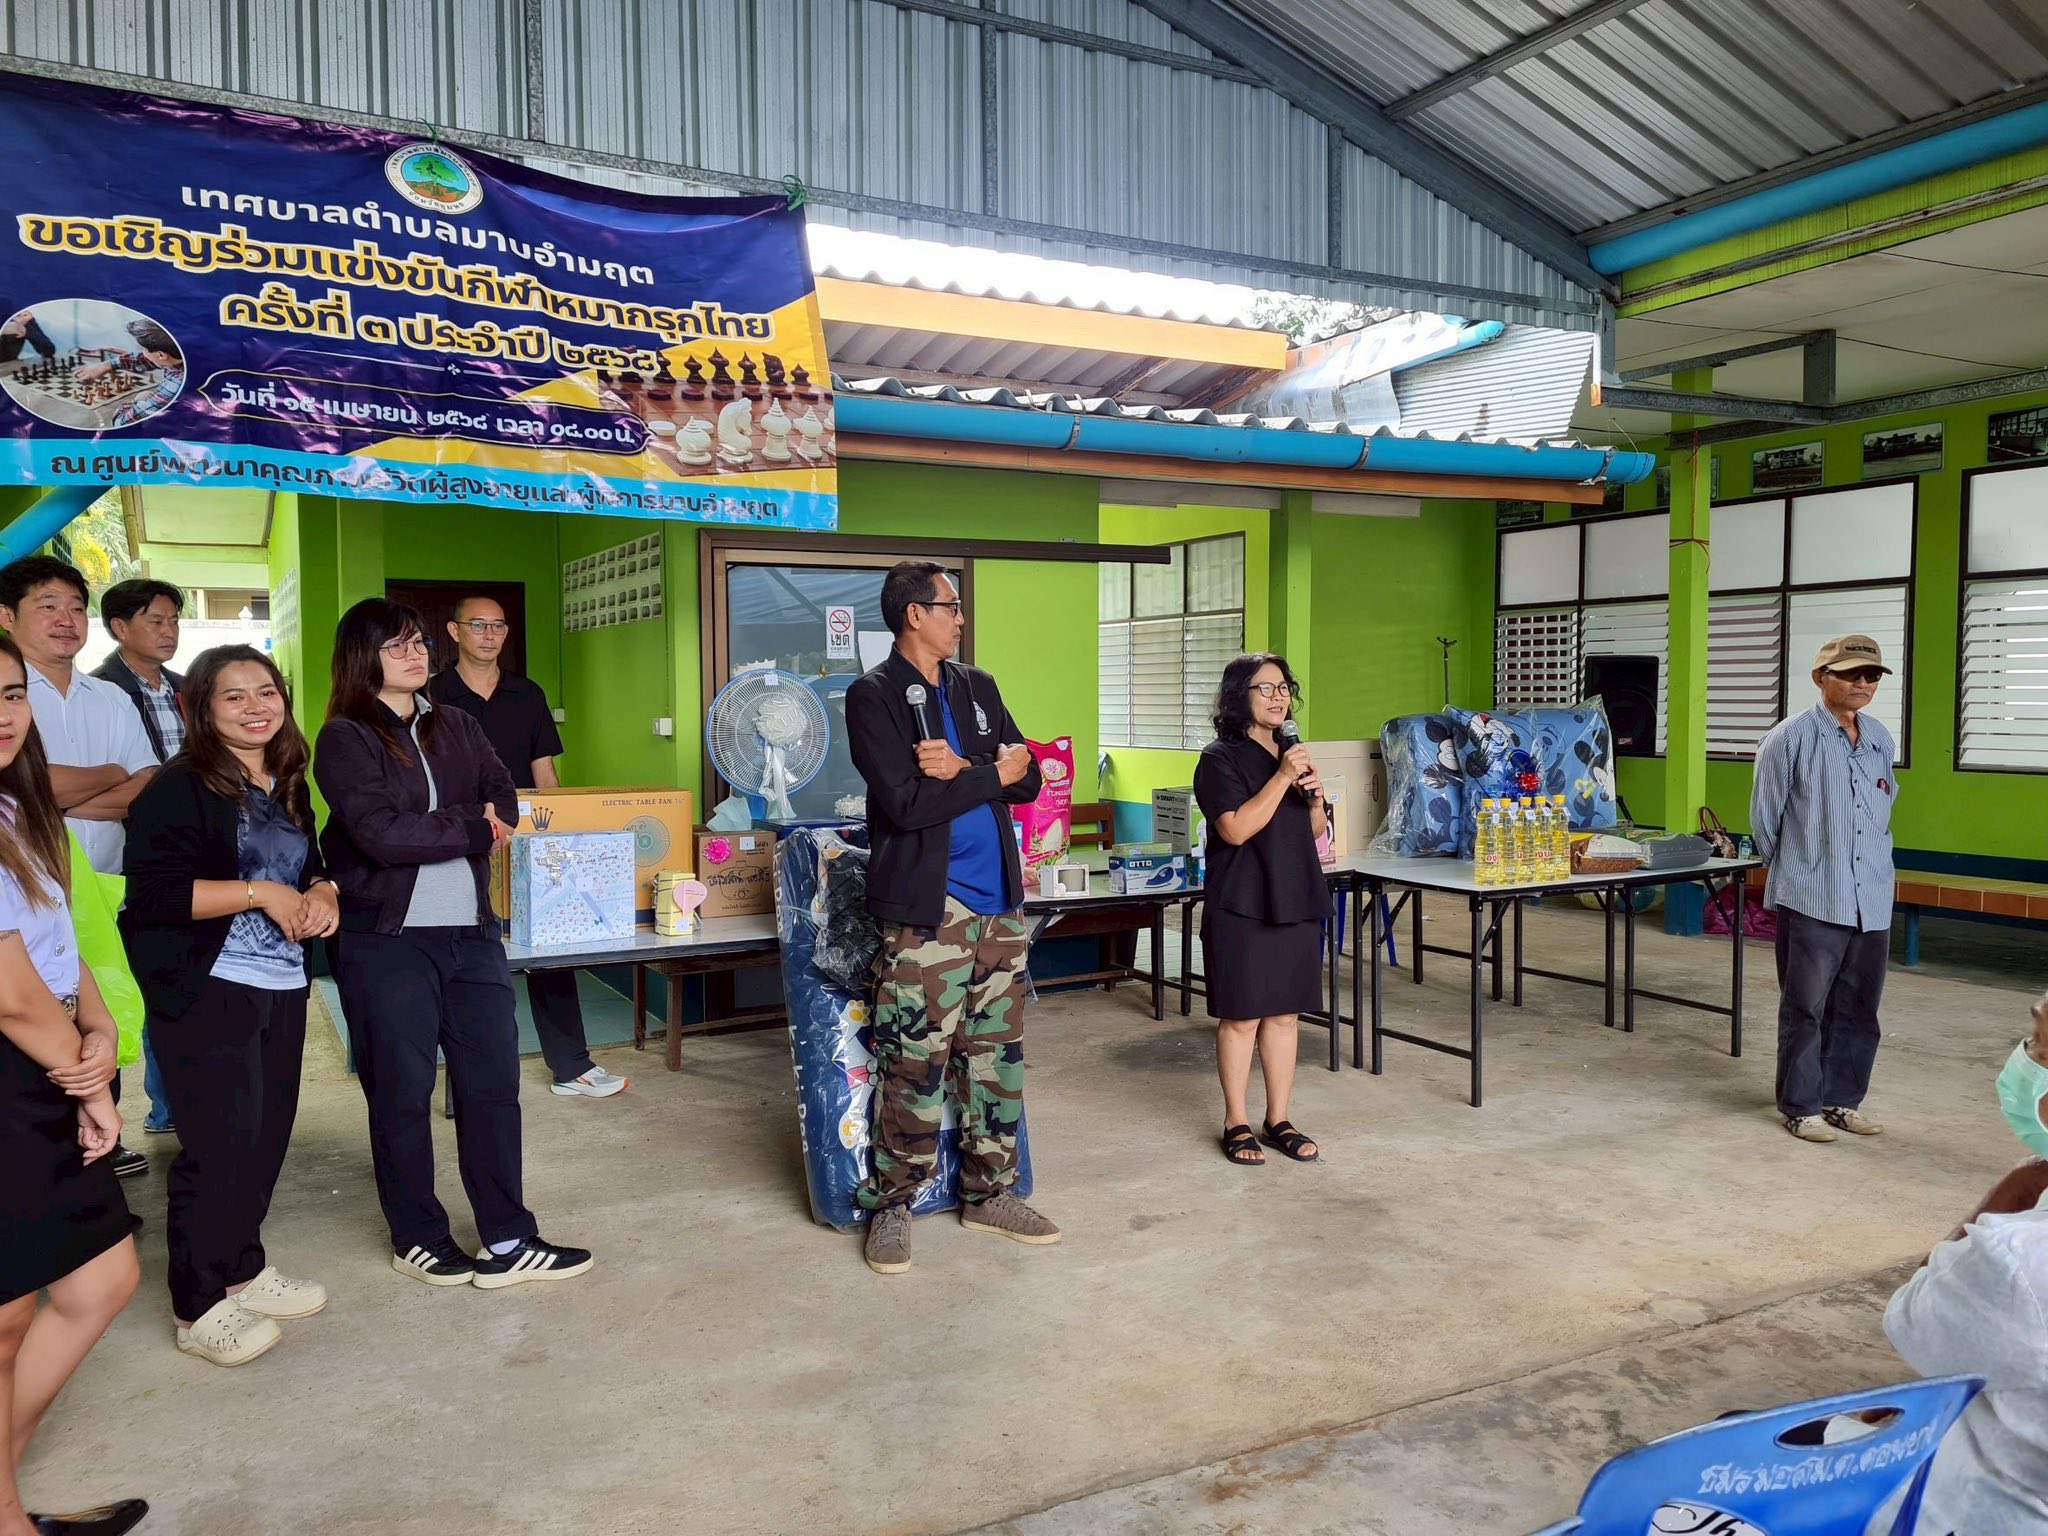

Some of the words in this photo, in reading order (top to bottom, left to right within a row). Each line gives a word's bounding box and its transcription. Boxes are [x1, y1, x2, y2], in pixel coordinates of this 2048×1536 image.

[180, 185, 655, 288] เทศบาลตำบลมาบอำมฤต
[23, 215, 773, 342] ขอเชิญร่วมแข่งขันกีฬาหมากรุกไทย
[225, 283, 350, 336] ครั้งที่
[362, 314, 395, 342] ๓
[402, 317, 548, 361] ประจำปี
[554, 339, 660, 373] ๒๕๖๘
[221, 381, 276, 409] วันที่
[283, 396, 316, 413] ๑๕
[323, 399, 418, 425] เมษายน
[426, 409, 488, 431] ๒๕๖๘
[496, 417, 544, 436] เวลา
[614, 427, 636, 443] น.
[51, 454, 86, 475] ณ
[830, 633, 850, 647] เขต
[602, 799, 633, 807] ELECTRIC
[636, 798, 657, 806] TABLE
[1129, 860, 1153, 868] OTTO
